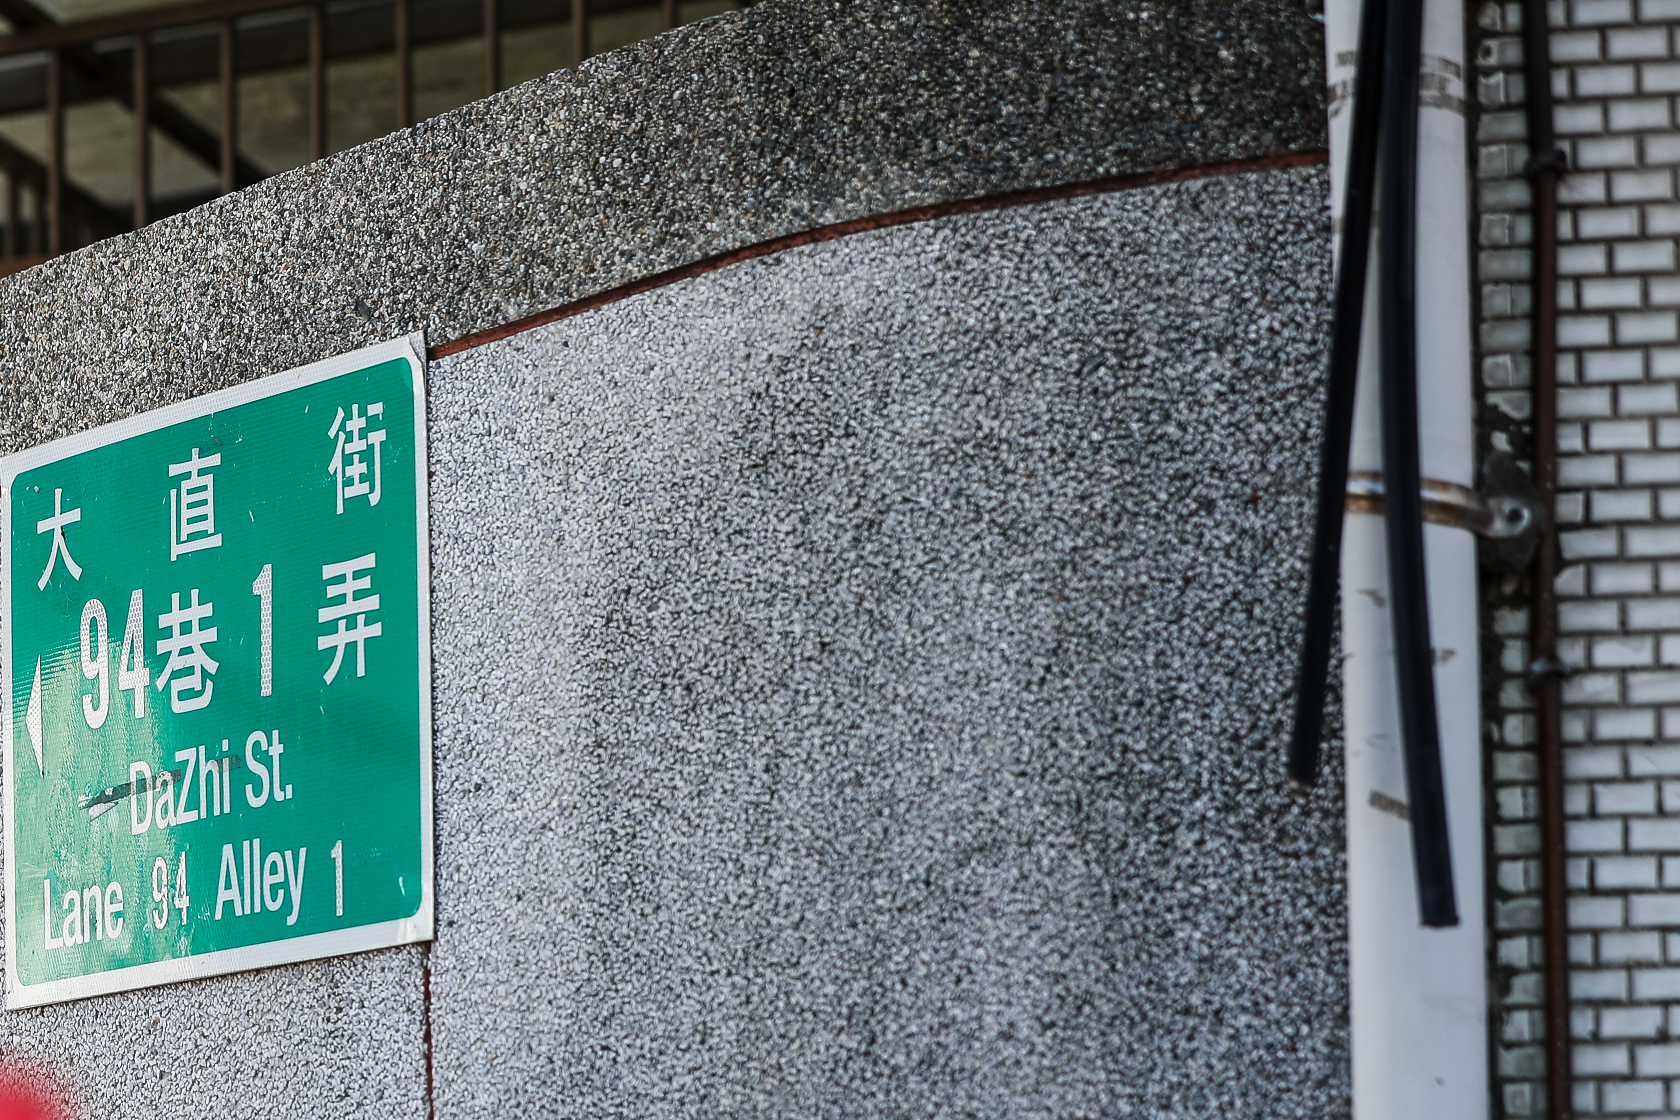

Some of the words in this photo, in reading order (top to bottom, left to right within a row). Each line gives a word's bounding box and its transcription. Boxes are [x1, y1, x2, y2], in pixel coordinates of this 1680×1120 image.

[37, 402, 388, 591] 大直街
[78, 552, 382, 729] 94巷1弄
[129, 737, 232, 836] DaZhi
[245, 729, 293, 809] St.
[42, 876, 124, 951] Lane
[151, 849, 191, 931] 94
[214, 836, 307, 927] Alley
[329, 838, 345, 917] 1
